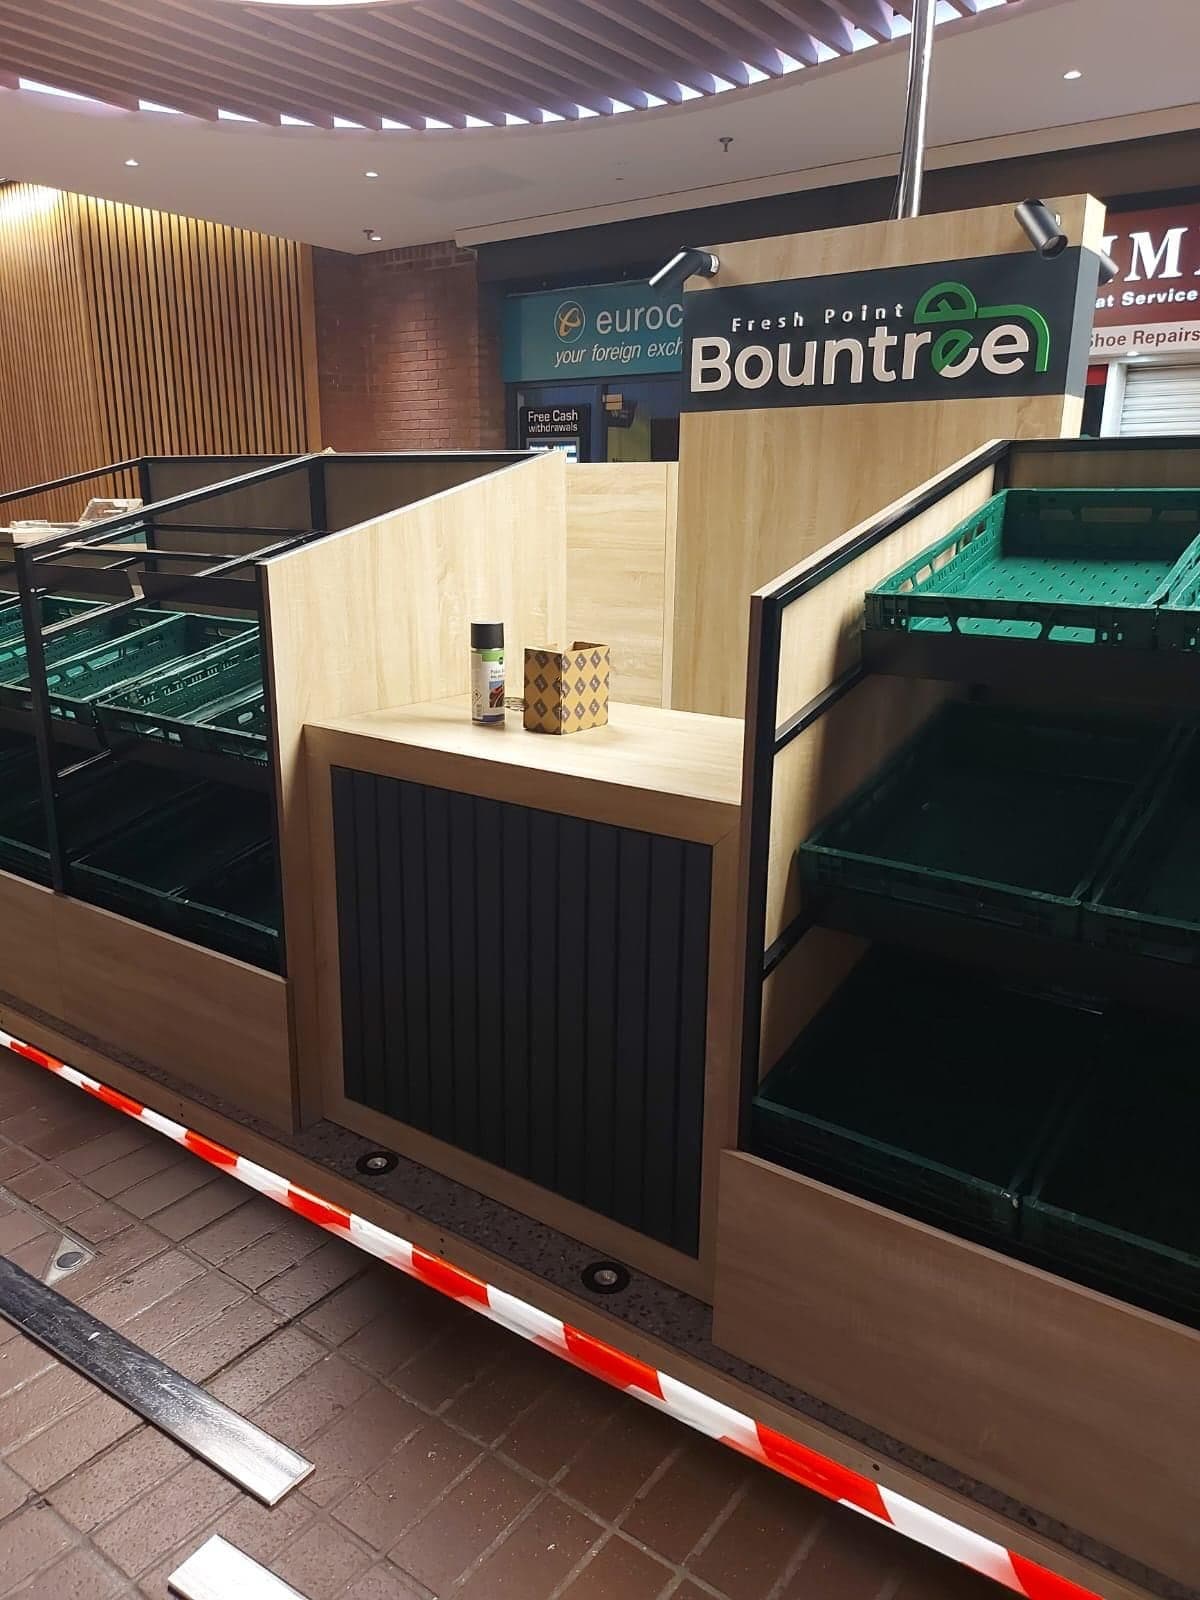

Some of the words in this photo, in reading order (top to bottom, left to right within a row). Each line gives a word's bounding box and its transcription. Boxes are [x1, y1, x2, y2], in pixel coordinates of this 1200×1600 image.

[1121, 287, 1199, 306] Service
[596, 302, 684, 335] euroc
[731, 310, 805, 333] Fresh
[824, 302, 905, 325] Point
[1132, 327, 1200, 347] Repairs
[554, 348, 586, 369] your
[591, 341, 642, 365] foreign
[690, 322, 1031, 393] Bountree
[528, 410, 551, 423] Free
[552, 408, 579, 422] Cash
[528, 421, 578, 434] withdrawals
